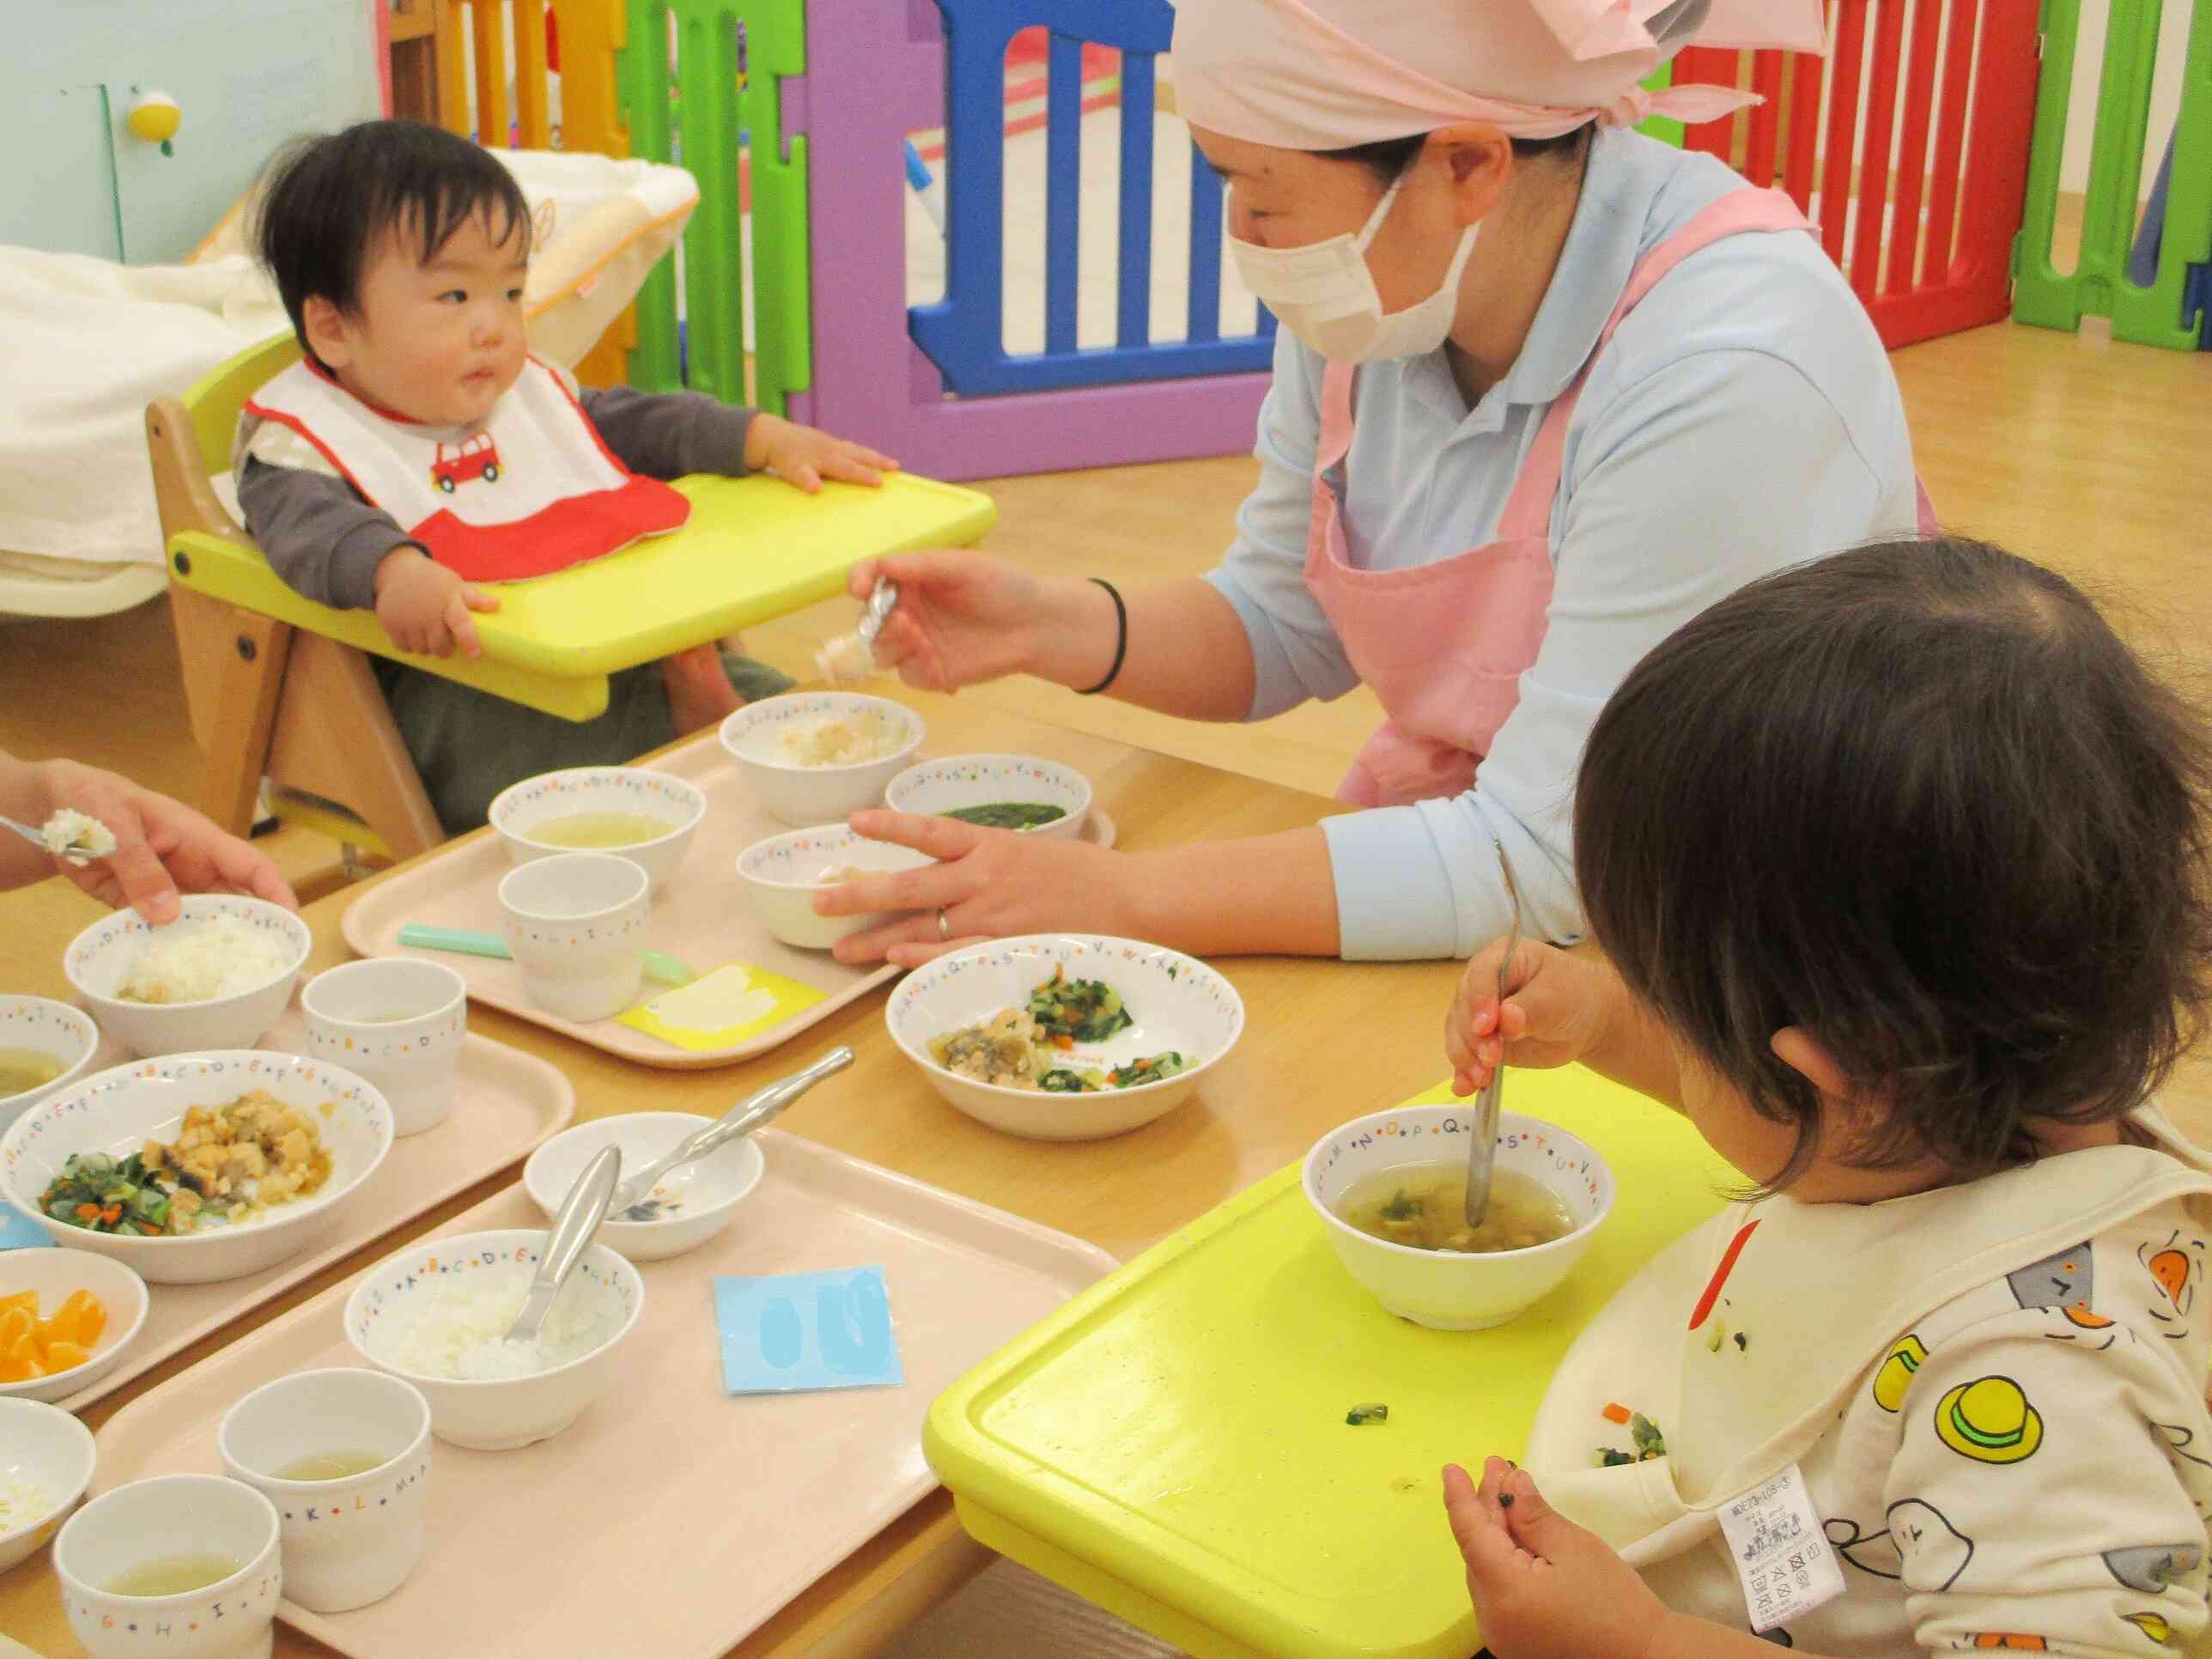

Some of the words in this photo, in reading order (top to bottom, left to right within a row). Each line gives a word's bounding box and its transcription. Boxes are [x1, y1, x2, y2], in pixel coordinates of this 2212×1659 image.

[1359, 1133, 1372, 1150] N
[1387, 1121, 1398, 1135] O
[1413, 1125, 1422, 1137] P
[1443, 1118, 1459, 1133] Q
[1508, 1135, 1518, 1149] S
[1557, 1157, 1567, 1170] U
[1580, 1160, 1589, 1174] V
[453, 1261, 463, 1273] C
[482, 1252, 495, 1264] D
[515, 1248, 528, 1262] E
[307, 1508, 319, 1521] K
[356, 1497, 366, 1511] L
[212, 1603, 223, 1618] I
